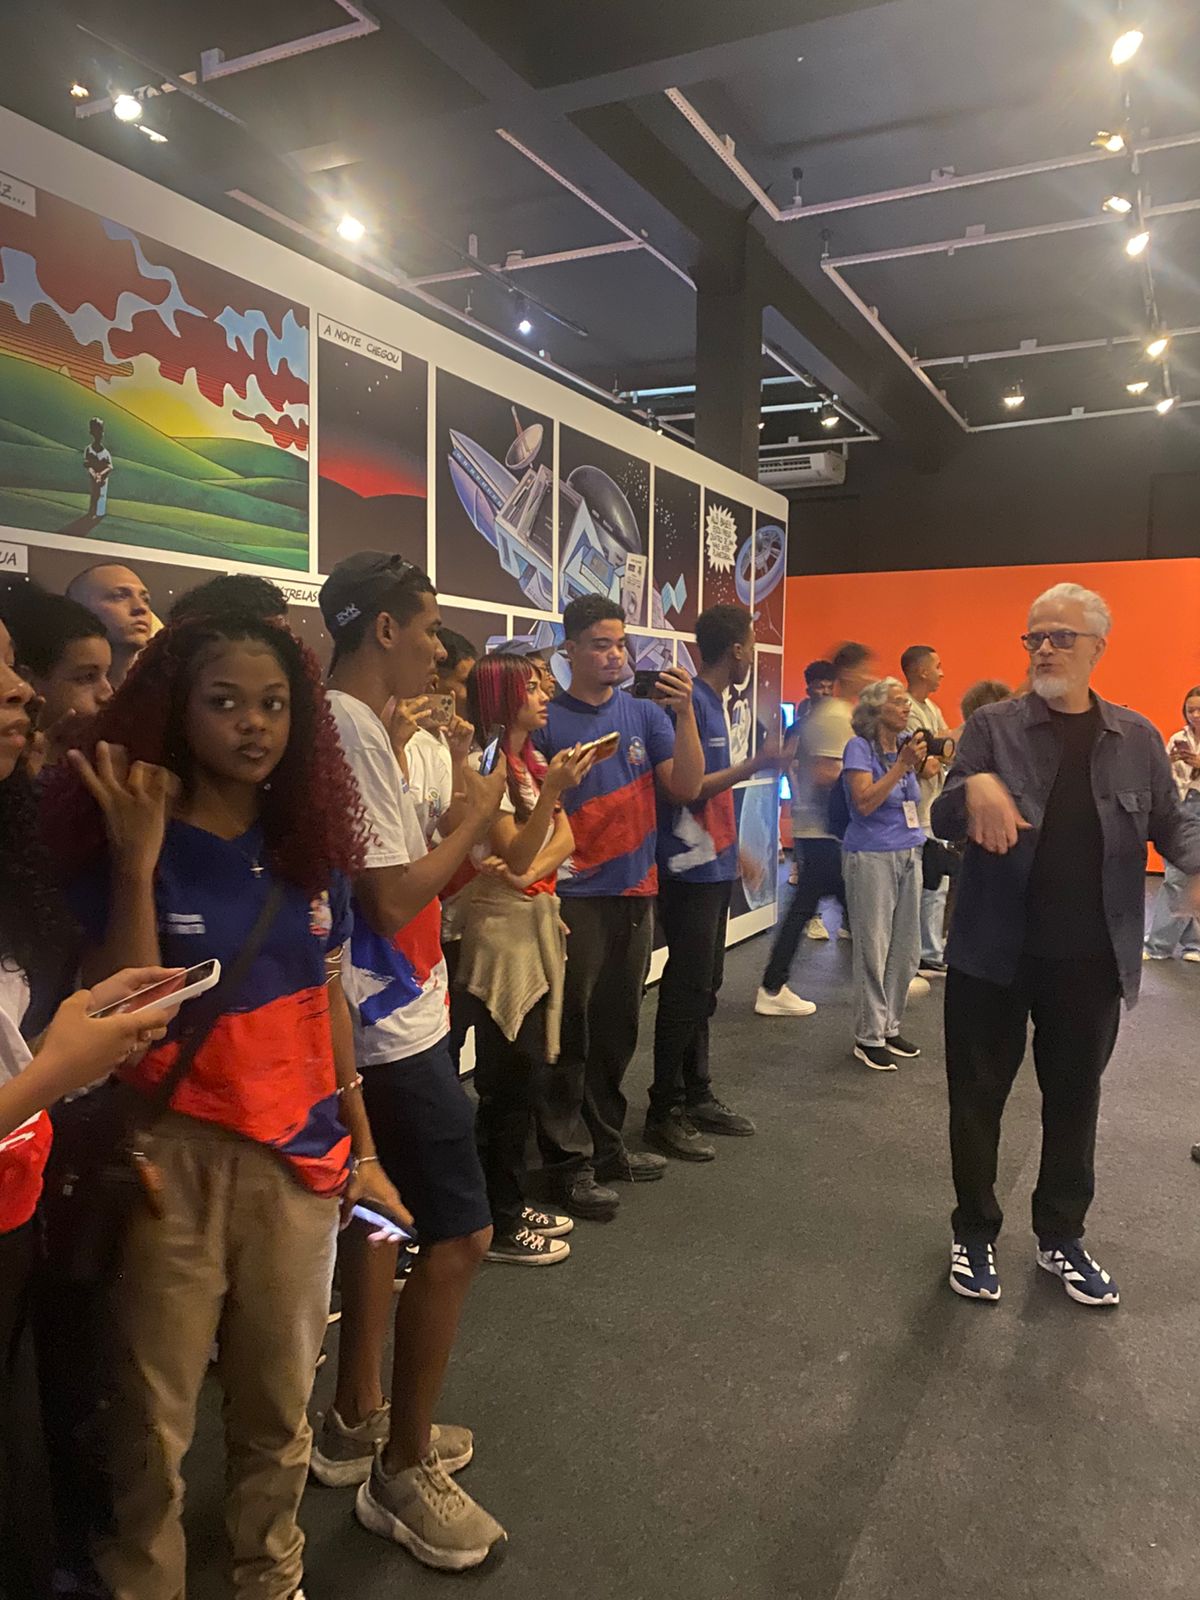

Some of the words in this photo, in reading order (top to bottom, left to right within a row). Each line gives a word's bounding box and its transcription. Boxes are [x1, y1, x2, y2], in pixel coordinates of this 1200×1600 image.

[0, 181, 26, 206] Z...
[323, 324, 332, 336] A
[334, 329, 361, 348] NOITE
[366, 343, 400, 364] CHEGOU
[280, 586, 318, 603] TRELAS
